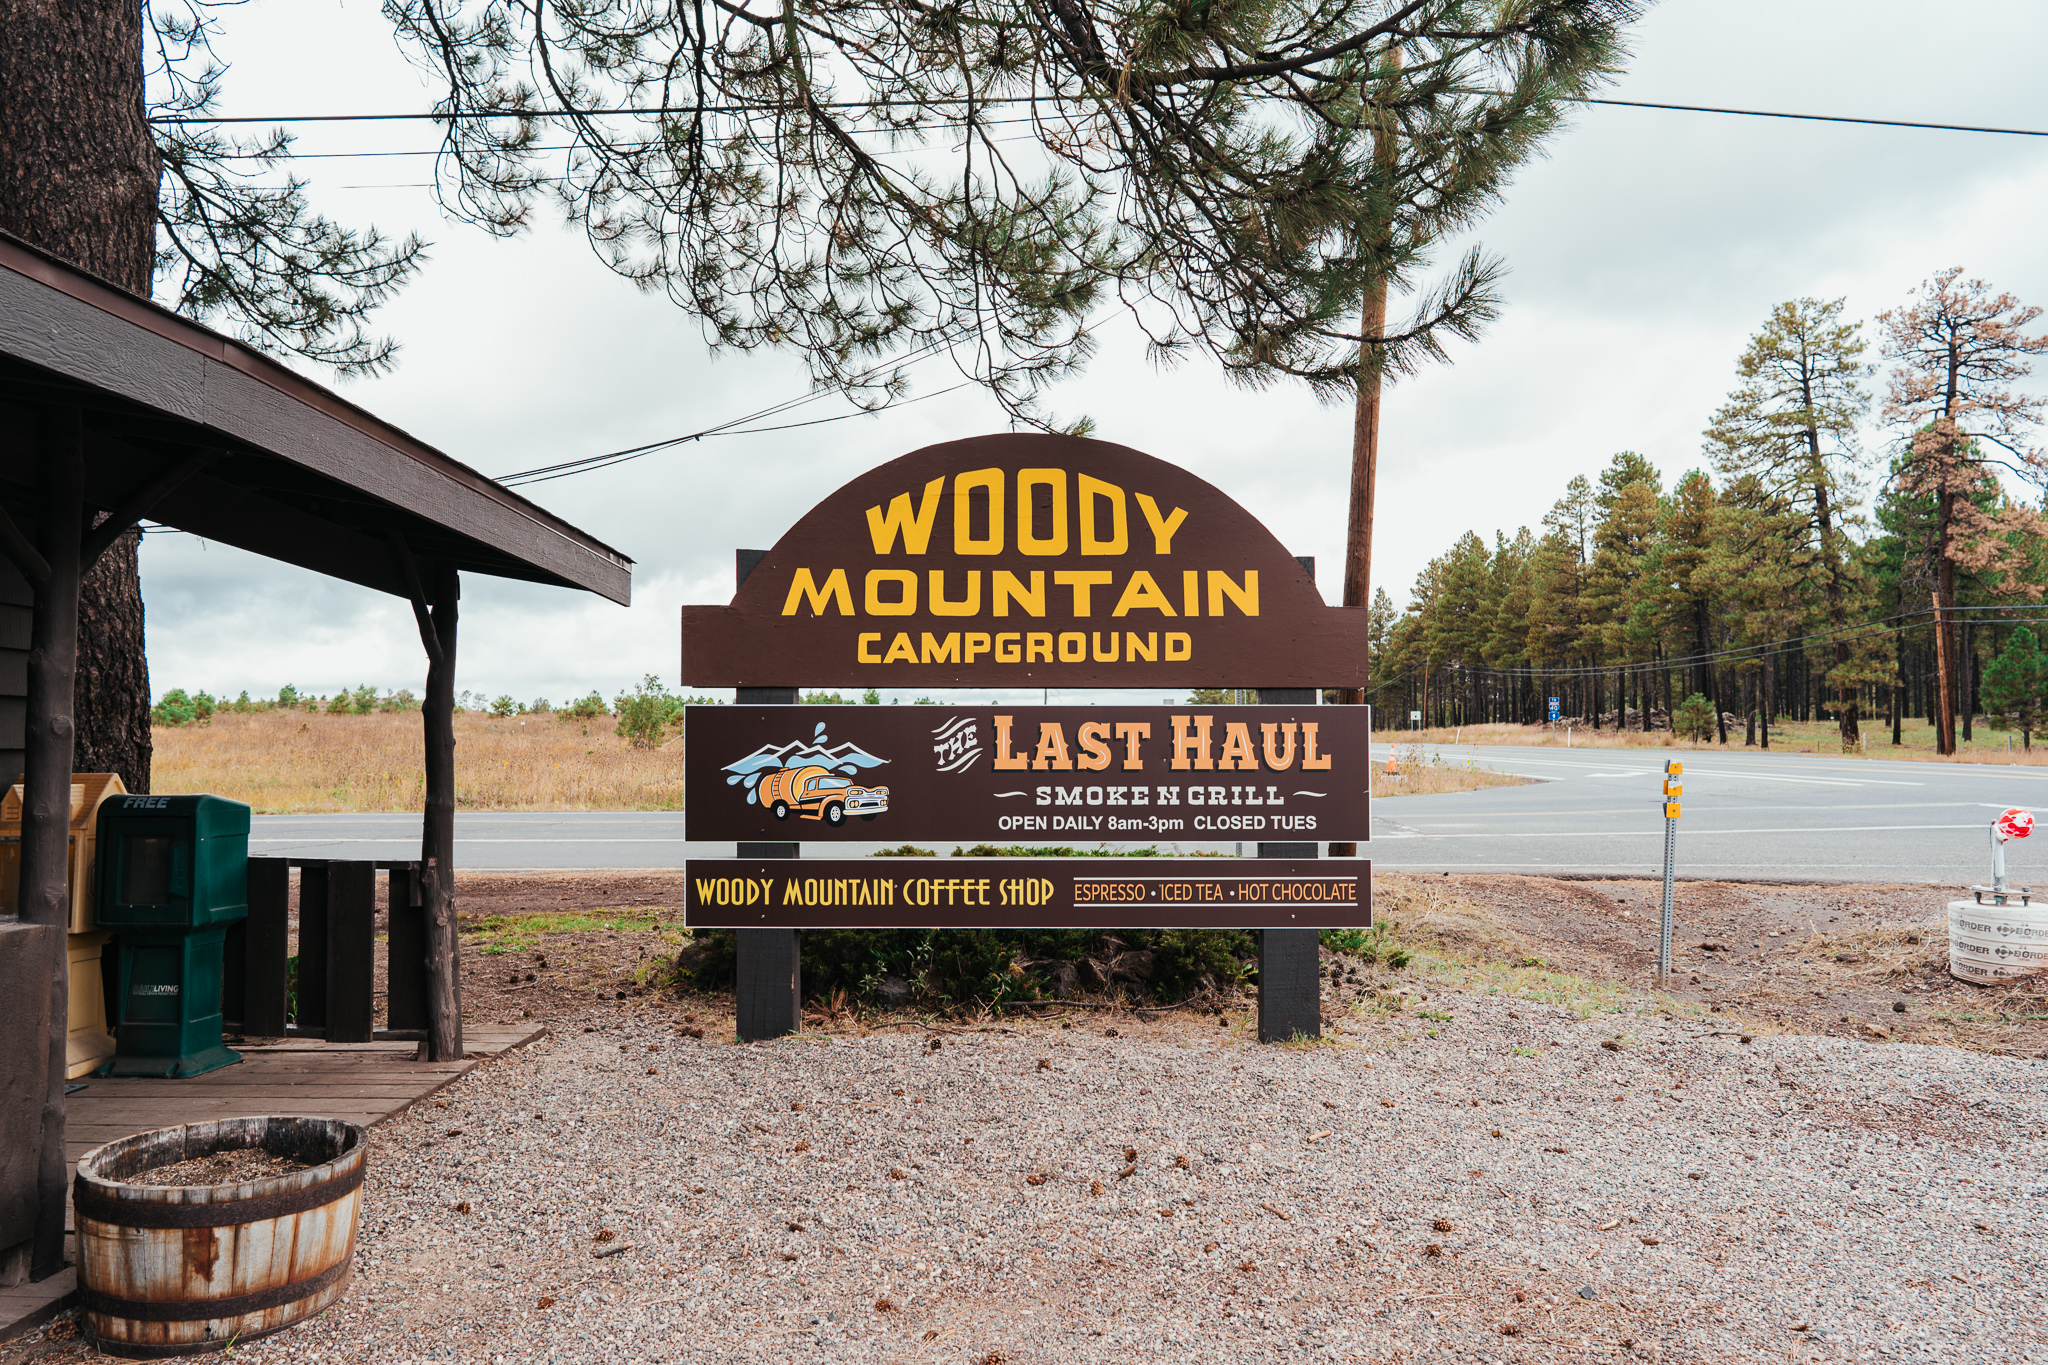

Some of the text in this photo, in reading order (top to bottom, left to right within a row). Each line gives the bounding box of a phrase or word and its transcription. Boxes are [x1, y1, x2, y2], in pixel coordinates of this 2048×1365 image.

[865, 467, 1189, 556] WOODY
[781, 567, 1260, 617] MOUNTAIN
[857, 631, 1192, 663] CAMPGROUND
[933, 724, 978, 766] THE
[992, 715, 1332, 772] LAST HAUL
[123, 797, 169, 809] FREE
[1036, 786, 1285, 806] SMOKE N GRILL
[998, 816, 1317, 833] OPEN DAILY 8am-3pm CLOSED TUES
[696, 878, 1054, 906] WOODY MOUNTAIN COFFEE SHOP
[1074, 883, 1357, 901] ESPRESSO ICED TEA HOT CHOCOLATE
